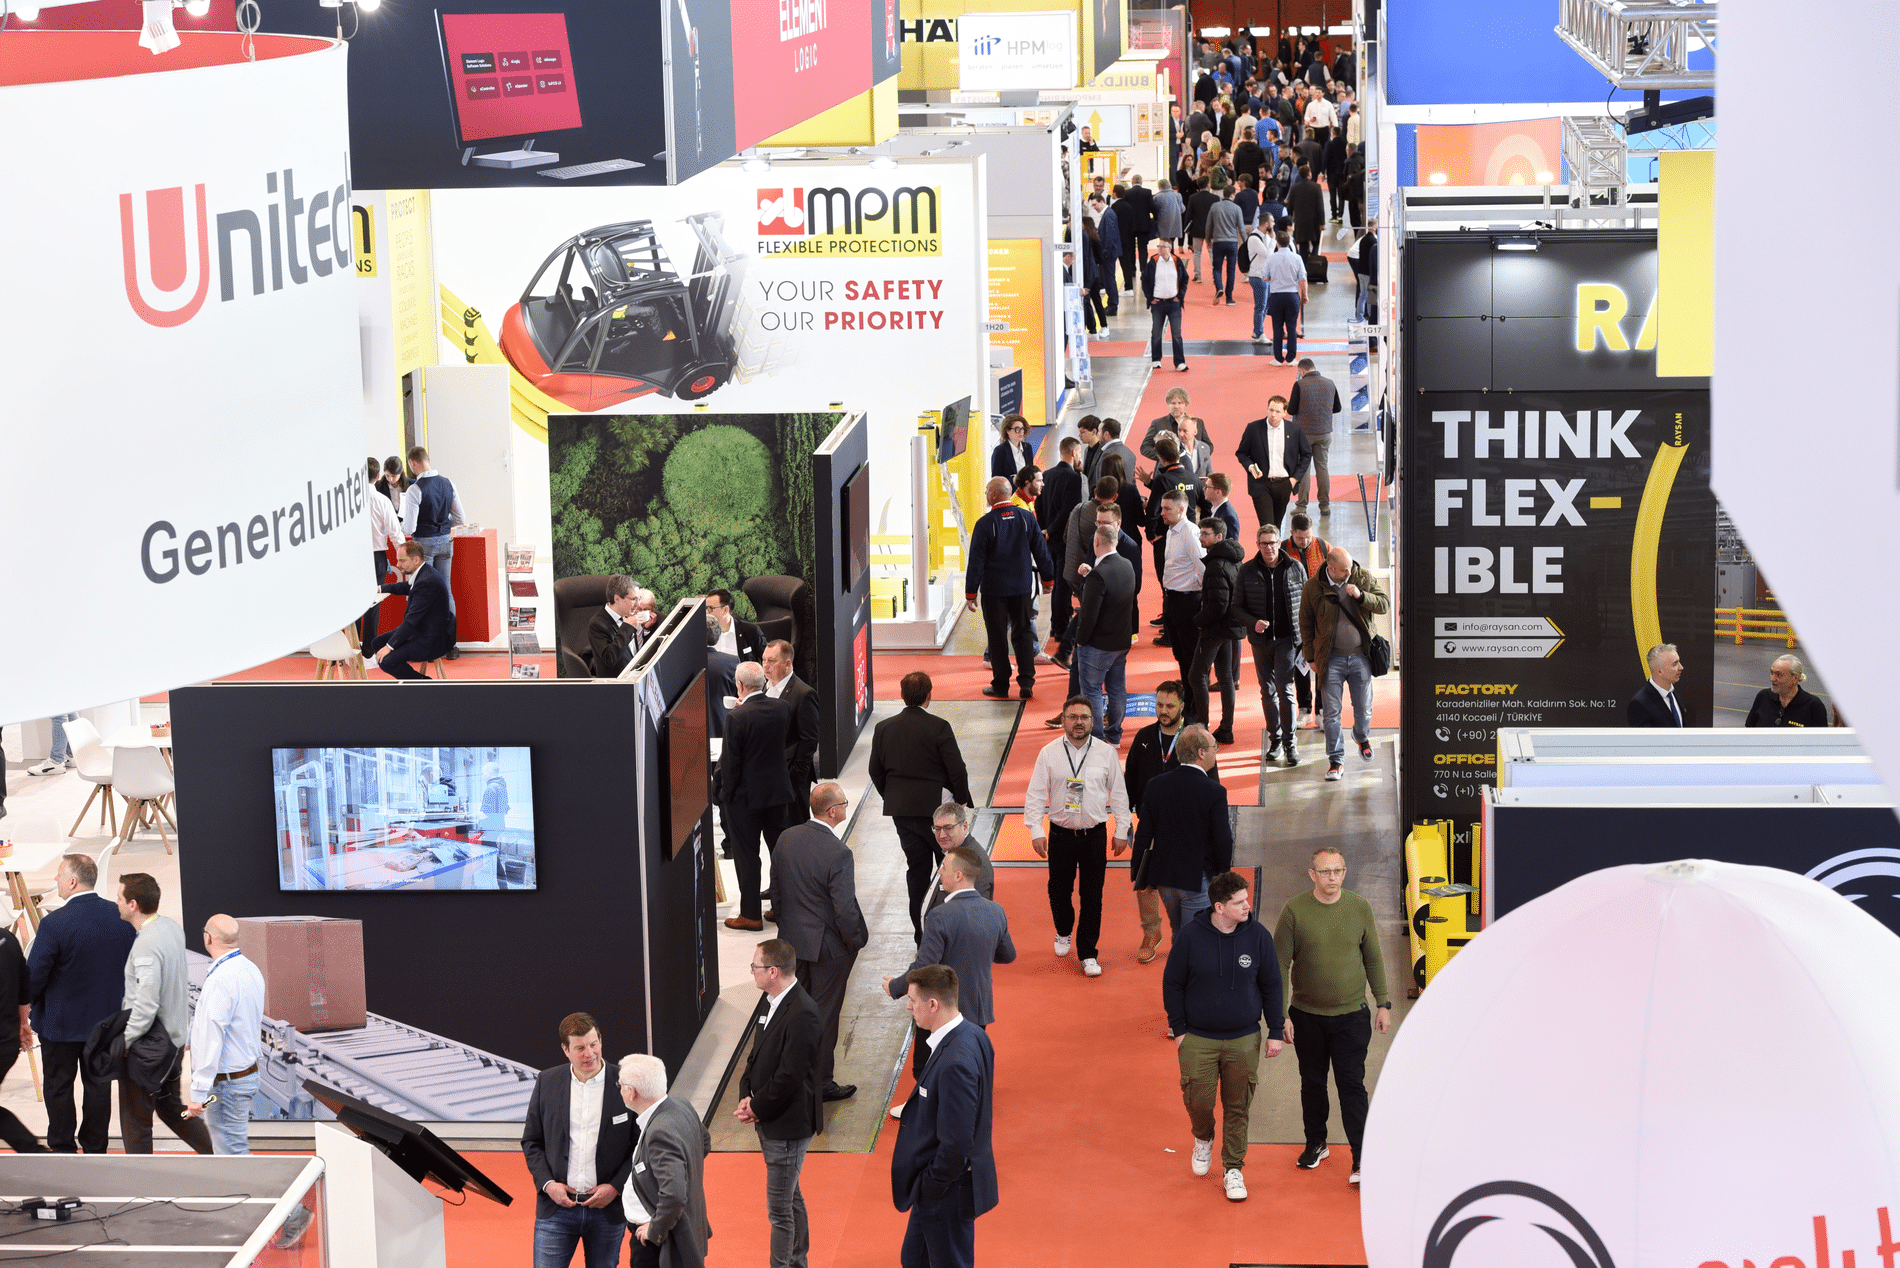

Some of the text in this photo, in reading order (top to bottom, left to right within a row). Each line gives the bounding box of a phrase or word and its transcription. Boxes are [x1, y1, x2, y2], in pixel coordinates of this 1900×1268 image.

[794, 43, 817, 73] LOGIC
[1001, 64, 1024, 72] planen
[758, 239, 938, 253] FLEXIBLE PROTECTIONS
[759, 280, 943, 301] YOUR SAFETY
[761, 311, 944, 331] OUR PRIORITY
[1432, 410, 1642, 458] THINK
[1674, 412, 1683, 446] RAYSAN
[1434, 478, 1622, 527] FLEX-
[1434, 546, 1564, 594] IBLE
[1462, 622, 1543, 632] info@raysan.com
[1461, 644, 1543, 654] www.raysan.com
[1435, 684, 1518, 695] FACTORY
[1436, 699, 1617, 708] Karadenizliler Mah. Kaldırım Sok. No: 12
[1436, 713, 1460, 722] 41140
[1462, 713, 1497, 722] Kocaeli
[1499, 712, 1504, 723] /
[1457, 729, 1487, 741] (+90)
[1433, 754, 1496, 764] OFFICE
[1434, 770, 1497, 779] 770 N La Salle
[1455, 784, 1475, 797] (+1)
